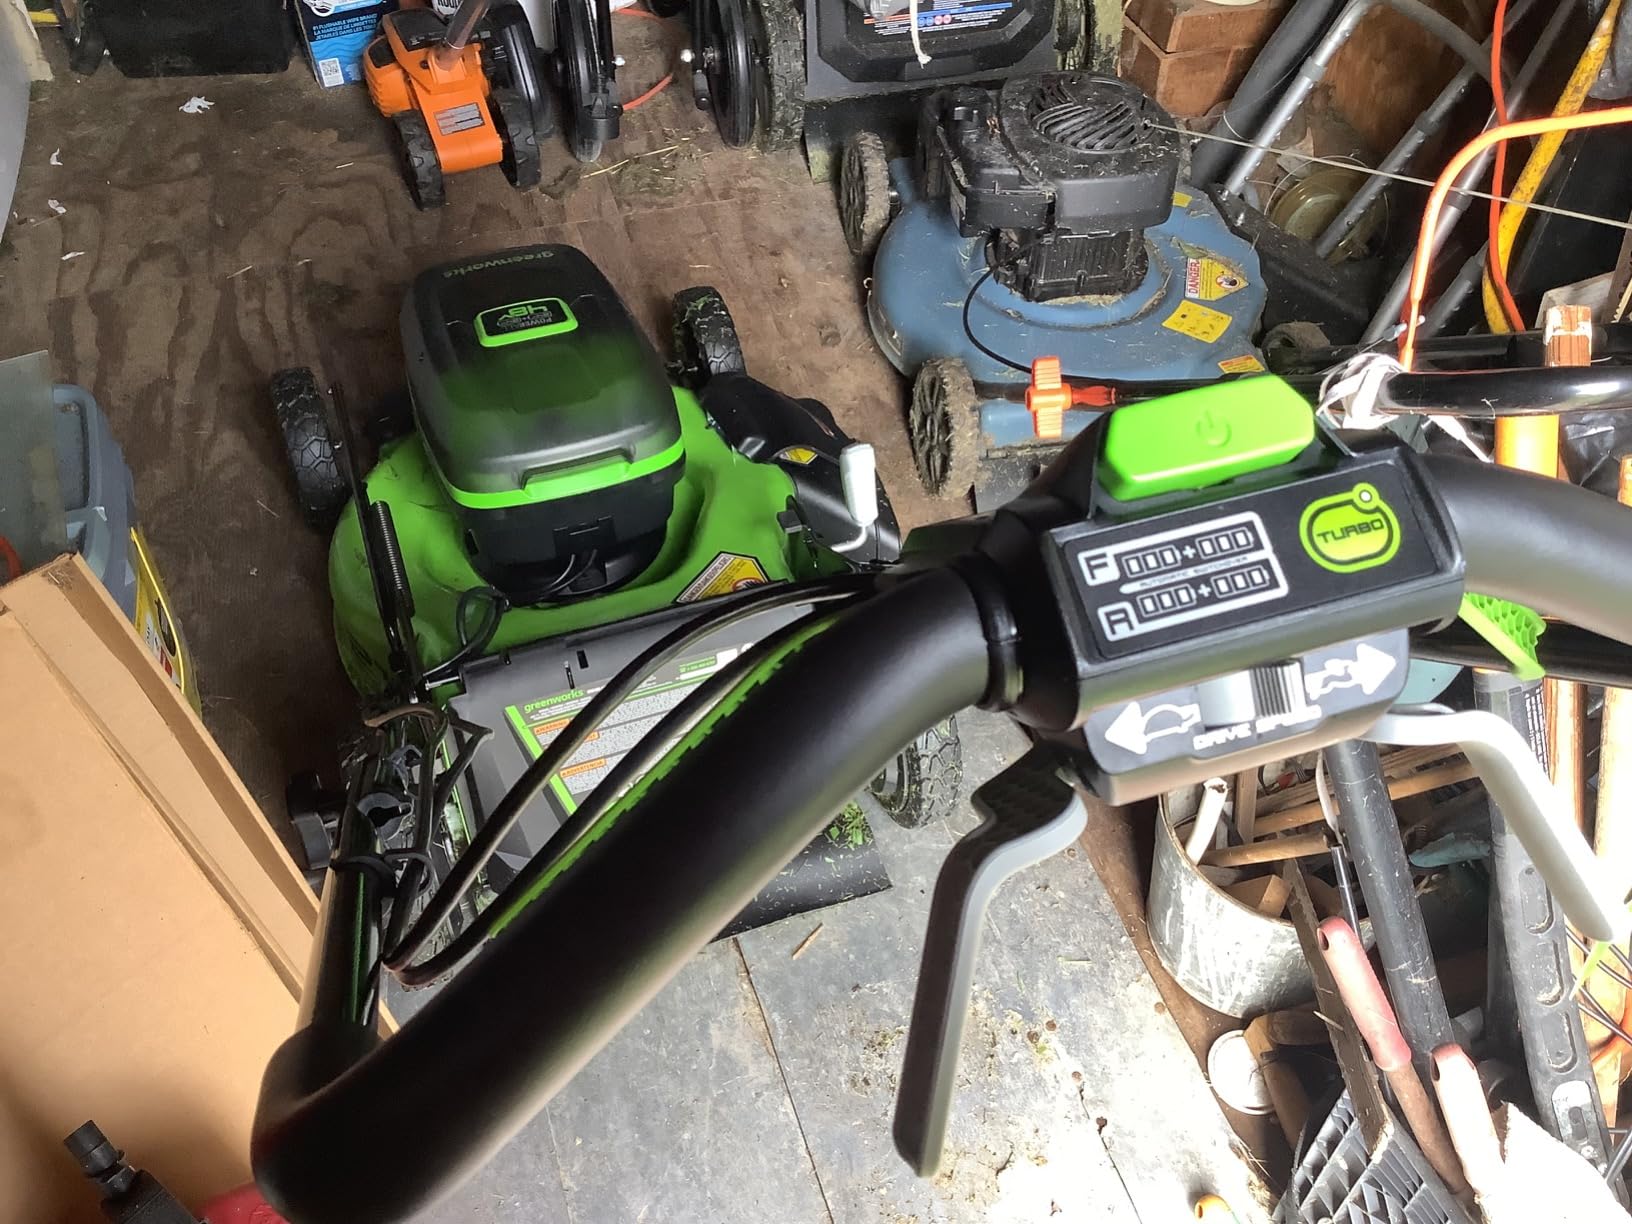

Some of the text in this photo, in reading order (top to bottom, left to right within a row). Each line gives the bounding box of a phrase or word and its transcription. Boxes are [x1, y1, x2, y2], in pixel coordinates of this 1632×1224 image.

[443, 250, 554, 278] greenworks
[1189, 262, 1201, 295] DANGER
[1317, 518, 1385, 544] TURBO
[1085, 552, 1109, 581] F
[524, 689, 584, 713] greenworks
